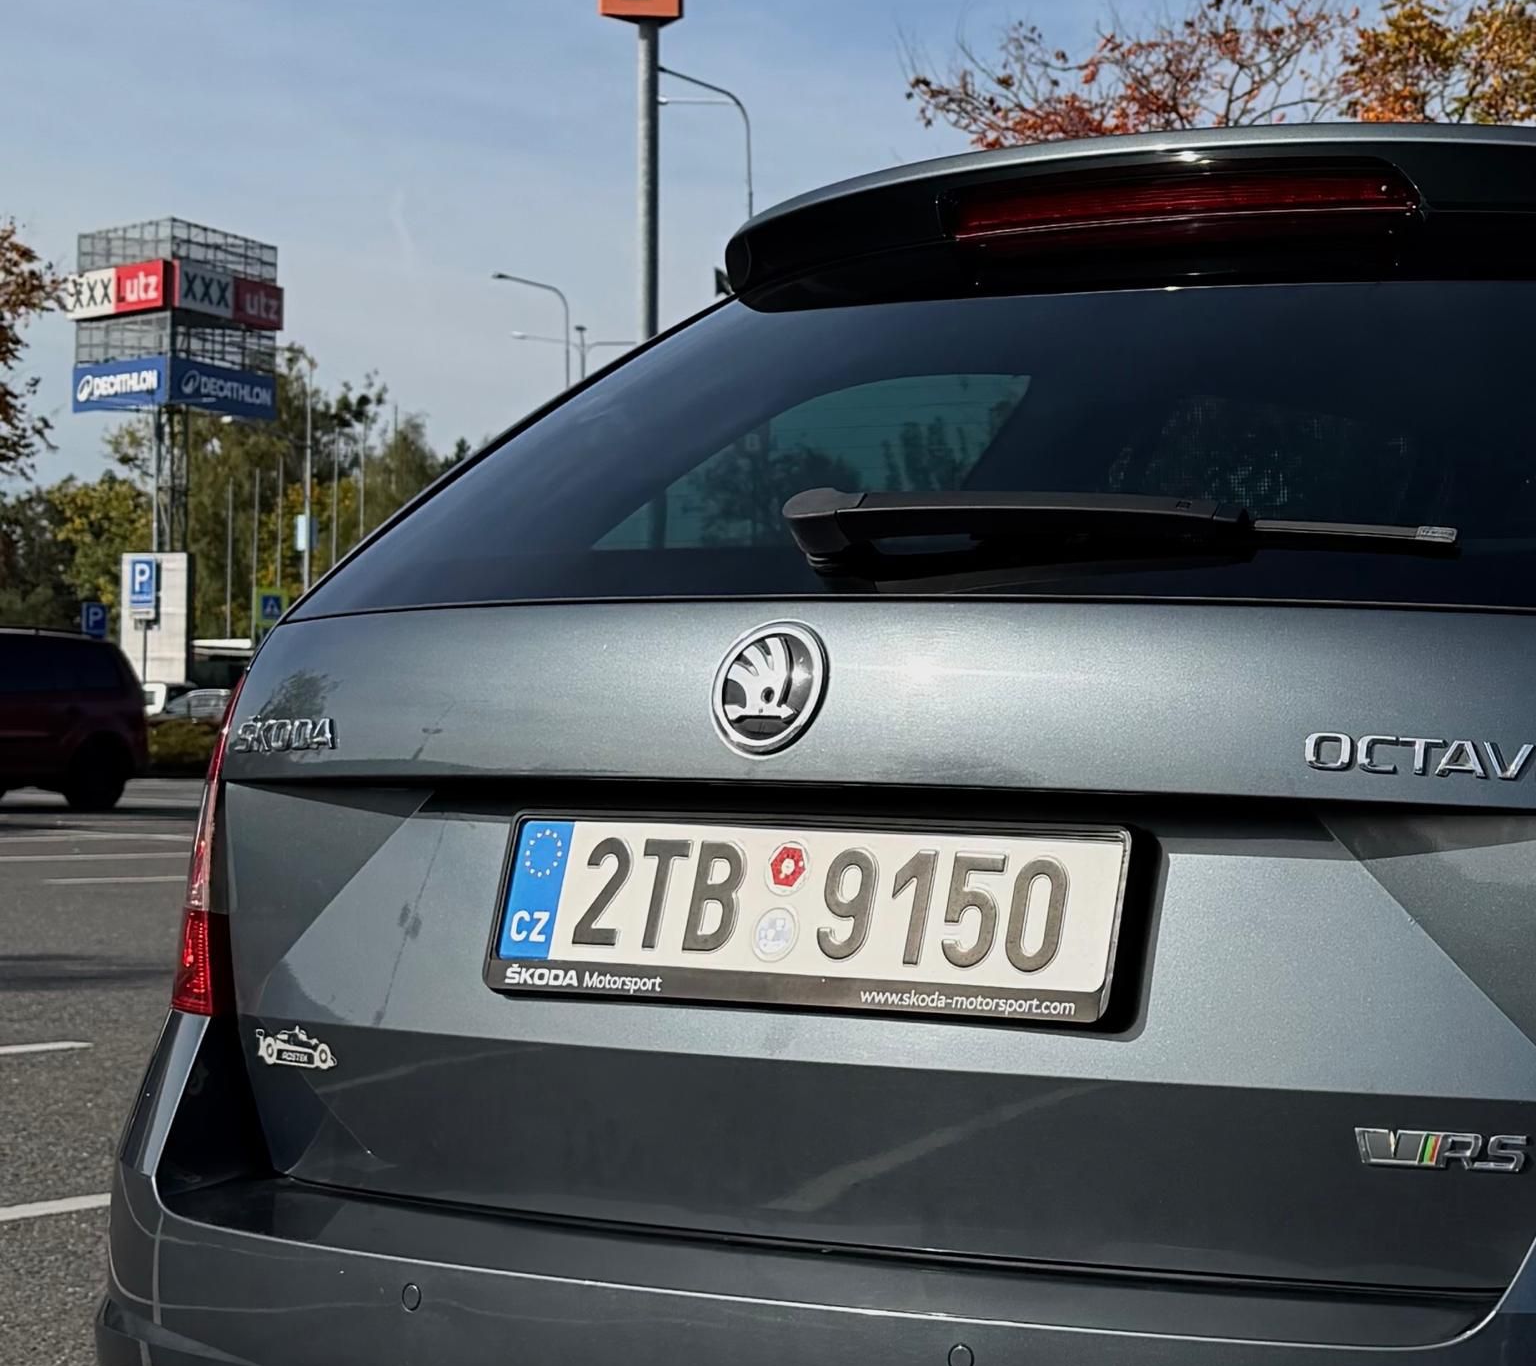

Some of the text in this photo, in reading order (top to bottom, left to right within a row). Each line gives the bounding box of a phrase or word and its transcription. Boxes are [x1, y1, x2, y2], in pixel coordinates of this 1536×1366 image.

[93, 370, 158, 396] DECATHLON
[200, 375, 272, 406] DECATHLON
[134, 562, 151, 593] P
[88, 606, 104, 628] P
[234, 715, 336, 753] ŠKODA
[571, 835, 1070, 975] 2TB 9150
[510, 909, 550, 943] CZ
[504, 963, 663, 995] ŠKODA Motorsport
[859, 989, 1076, 1016] www.skoda-motorsport.com
